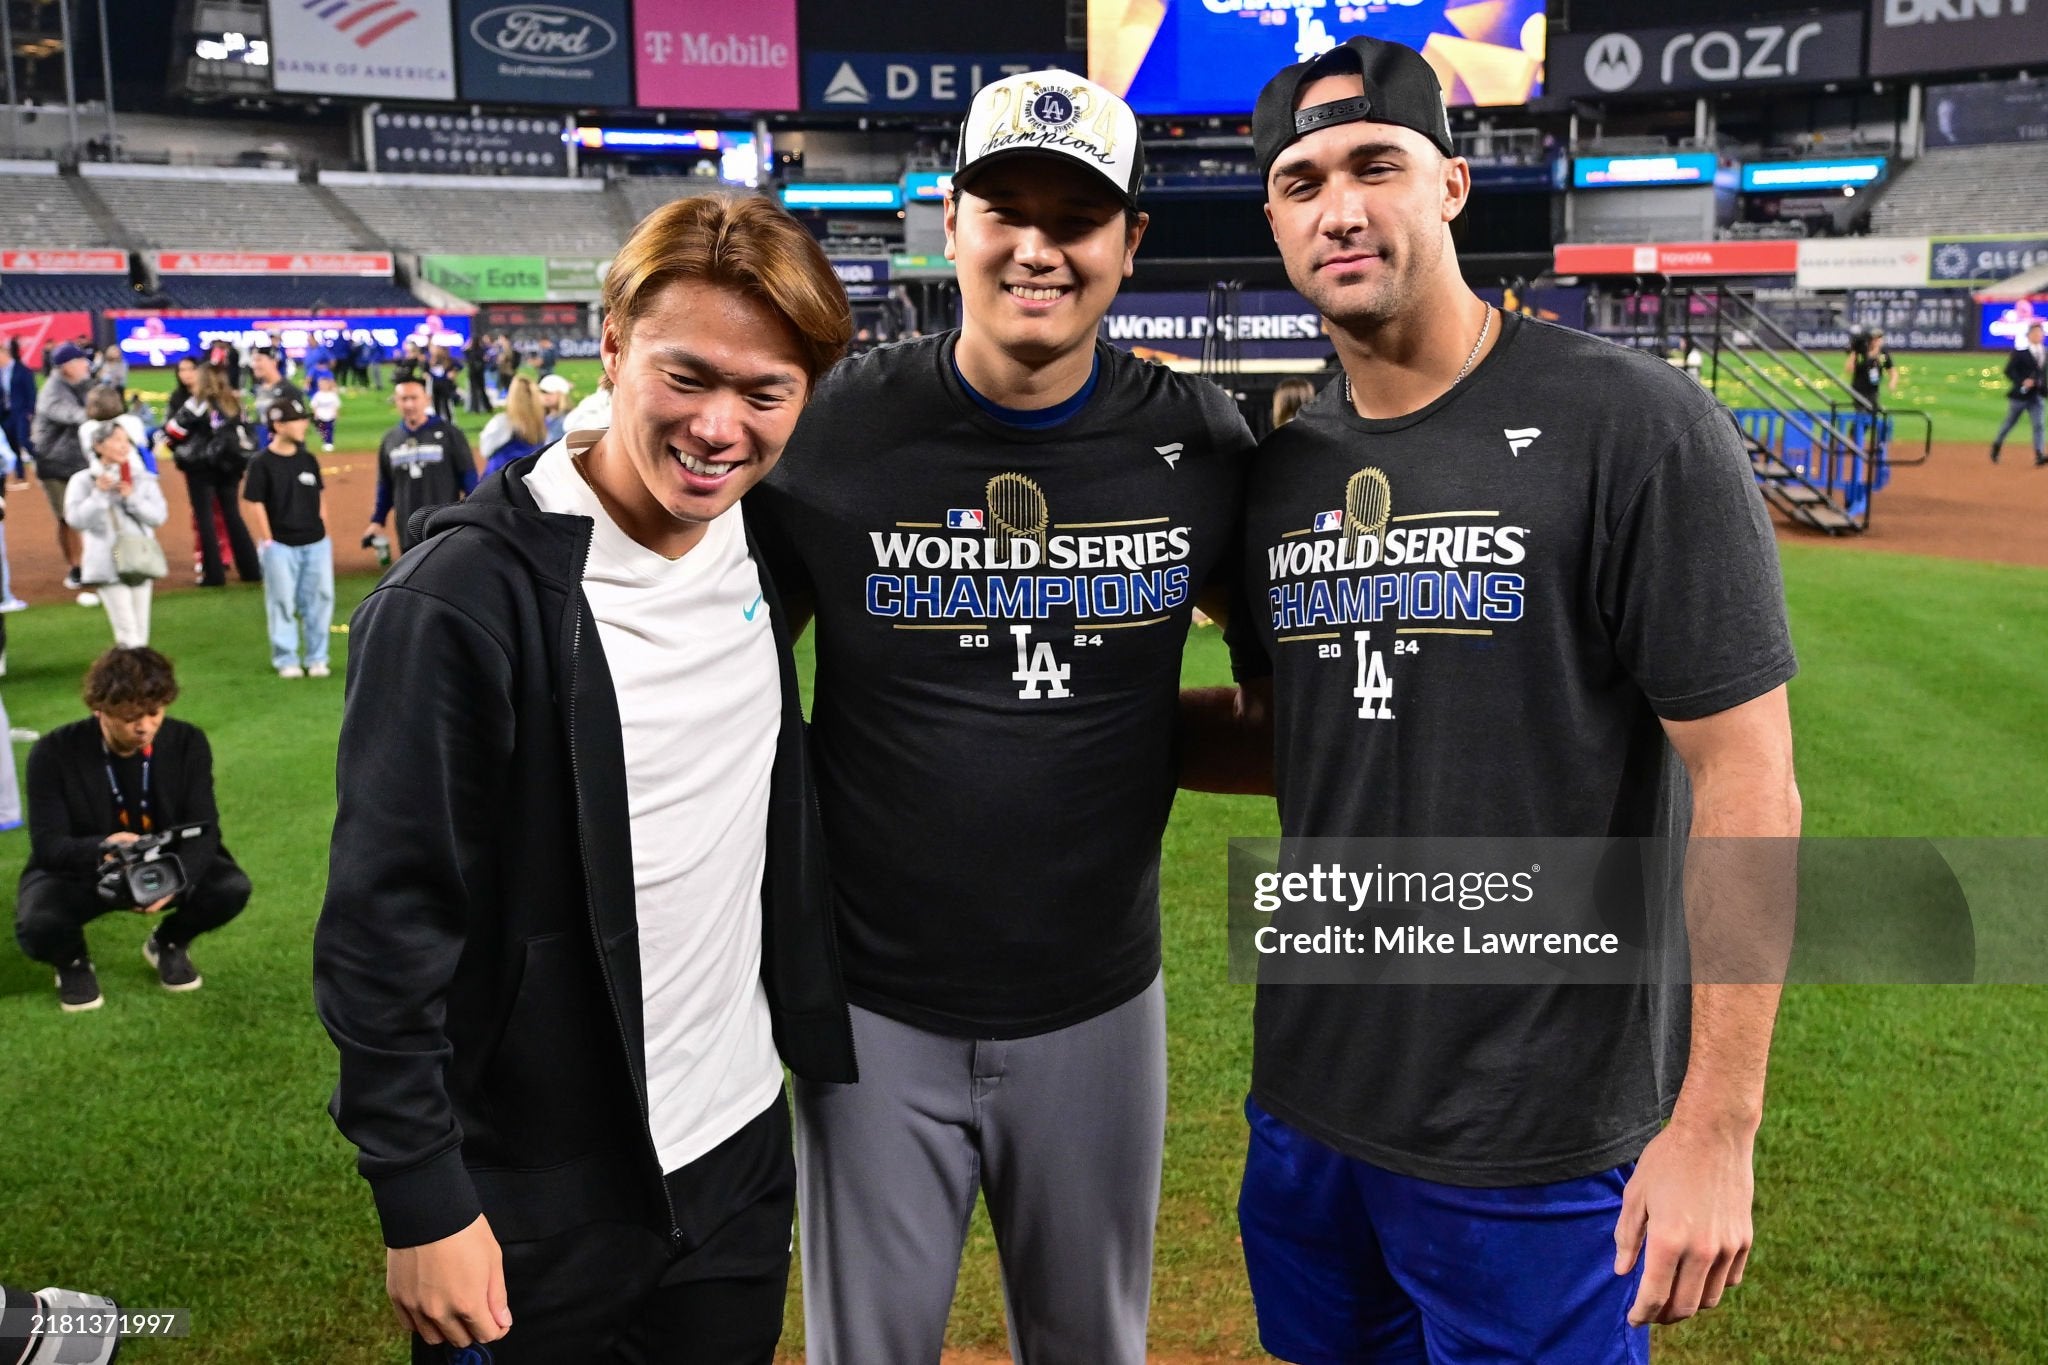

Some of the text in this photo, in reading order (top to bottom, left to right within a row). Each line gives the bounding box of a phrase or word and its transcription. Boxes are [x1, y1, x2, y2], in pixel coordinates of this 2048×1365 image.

[496, 12, 590, 53] Ford
[681, 32, 788, 69] Mobile
[277, 60, 448, 80] BANK OF AMERICA
[1661, 22, 1823, 84] razr
[886, 64, 1057, 100] DELT
[1041, 95, 1065, 121] LA
[486, 267, 541, 289] Eats
[1104, 313, 1319, 341] WORLD SERIES
[869, 527, 1191, 570] WORLD SERIES
[1268, 526, 1526, 581] WORLD SERIES
[866, 564, 1189, 619] CHAMPIONS
[1268, 571, 1525, 631] CHAMPIONS
[959, 634, 1103, 648] 20 24
[1318, 639, 1420, 659] 20 24
[1009, 624, 1072, 700] LA
[1353, 630, 1394, 720] LA
